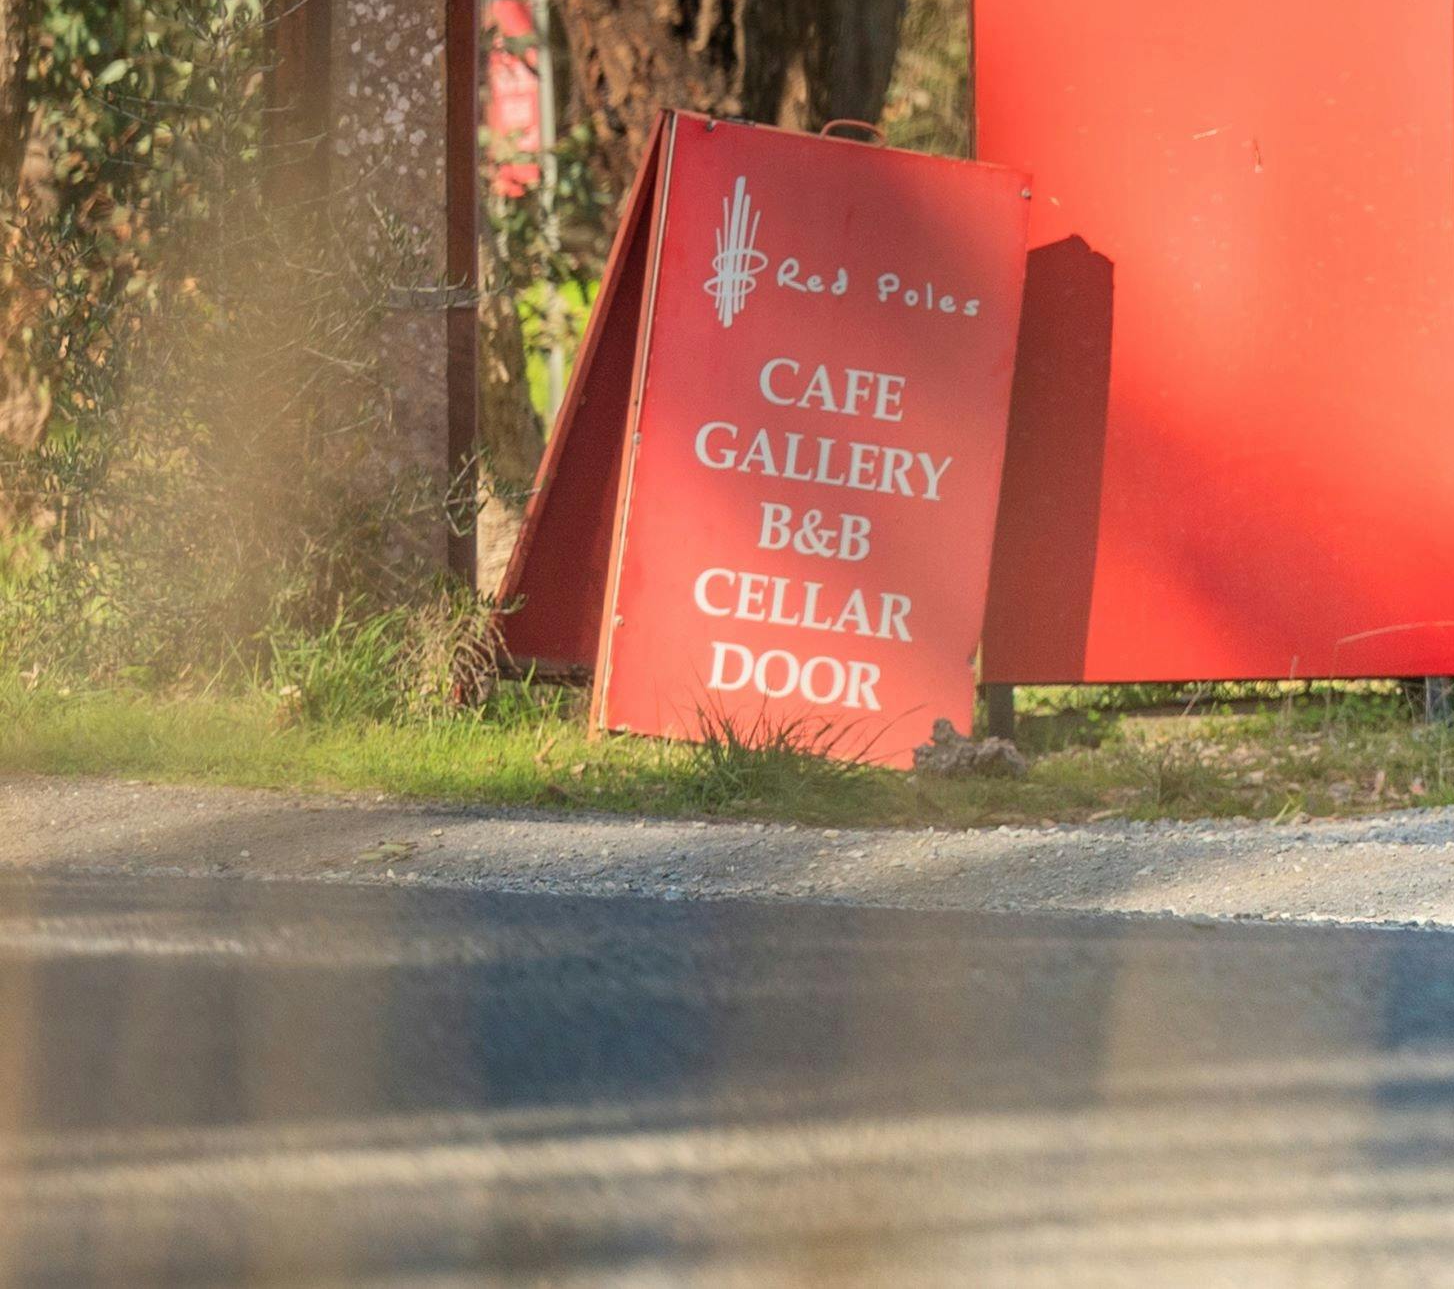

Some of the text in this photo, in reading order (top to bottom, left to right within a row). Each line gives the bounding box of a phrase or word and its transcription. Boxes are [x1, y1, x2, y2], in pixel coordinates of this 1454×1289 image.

[777, 258, 980, 316] Red Poles
[760, 358, 905, 421] CAFE
[695, 420, 953, 502] GALLERY
[758, 502, 871, 560] B&B
[693, 567, 913, 643] CELLAR
[708, 640, 882, 711] DOOR
